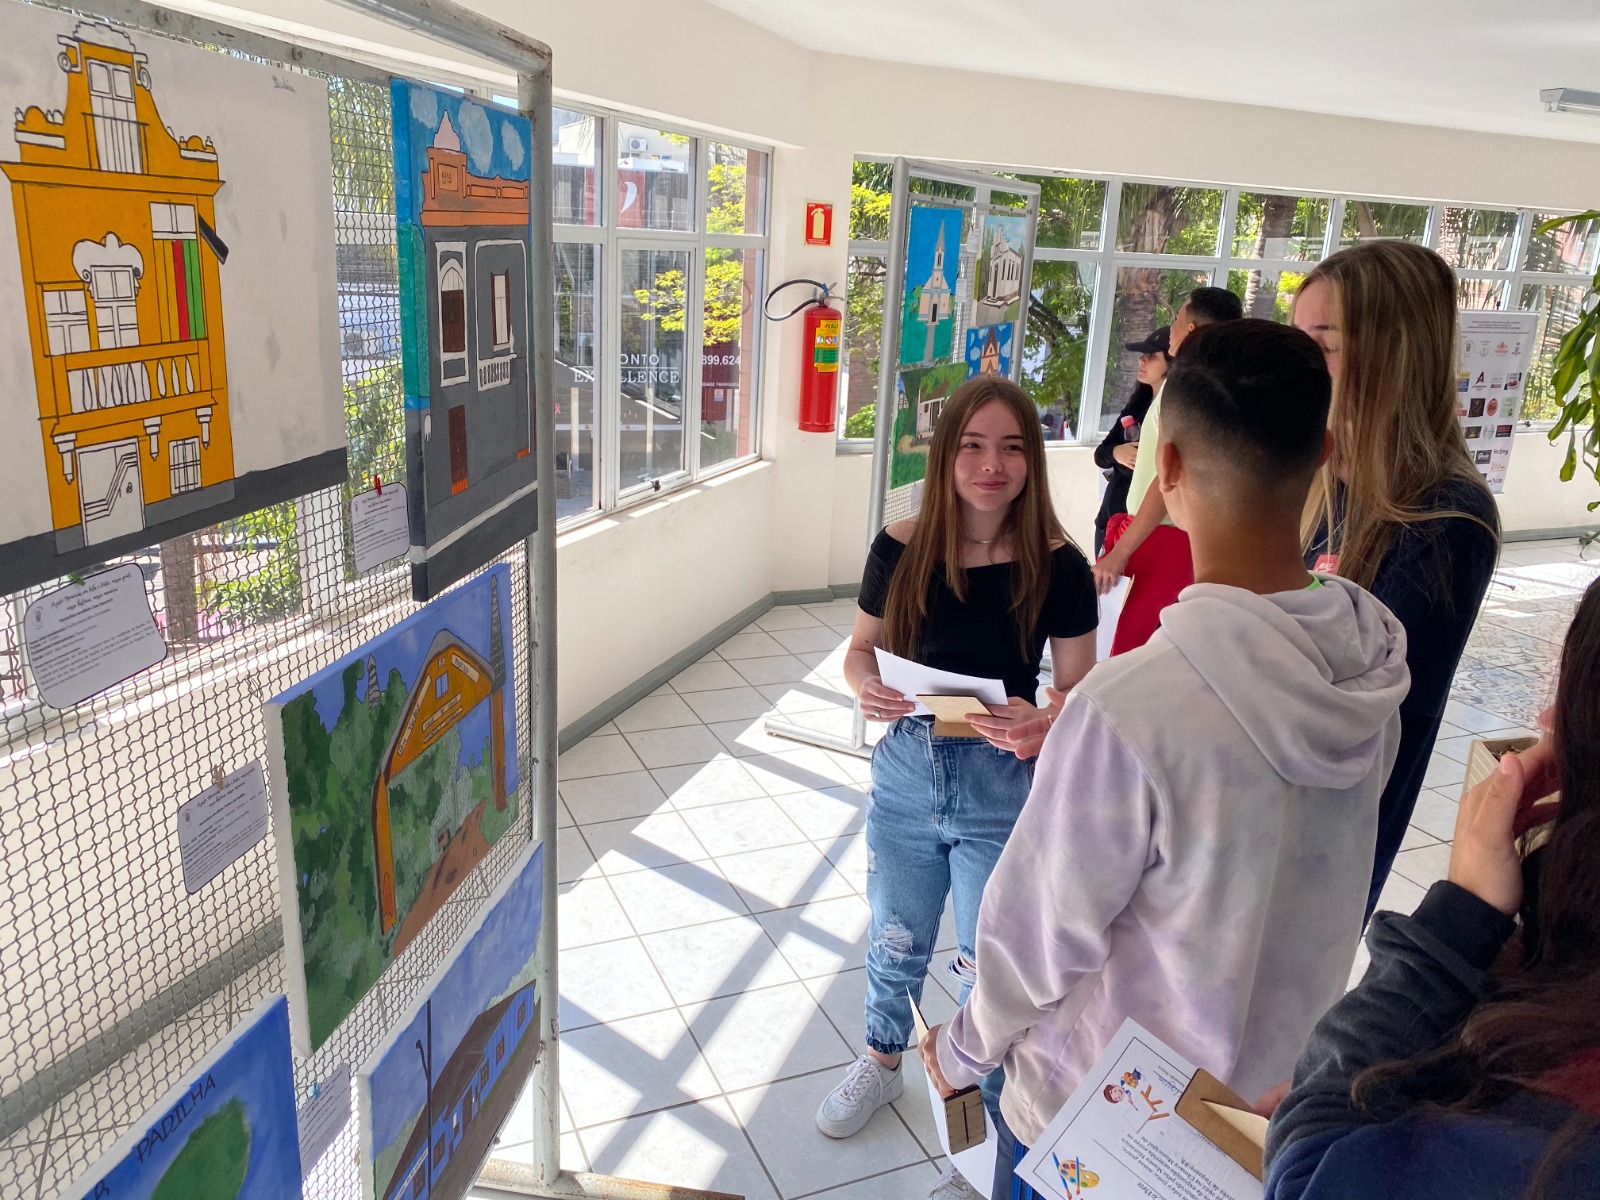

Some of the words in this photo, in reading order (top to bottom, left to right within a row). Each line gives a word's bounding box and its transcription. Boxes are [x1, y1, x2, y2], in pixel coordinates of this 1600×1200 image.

[620, 353, 660, 365] ONTO
[573, 370, 680, 383] EXLLENCE
[136, 1073, 216, 1164] PADILHA
[1147, 1141, 1175, 1165] Municipal
[1145, 1157, 1164, 1174] Museu
[1174, 1162, 1196, 1182] Câmara
[1162, 1171, 1177, 1184] pelo
[1169, 1168, 1197, 1191] exposição
